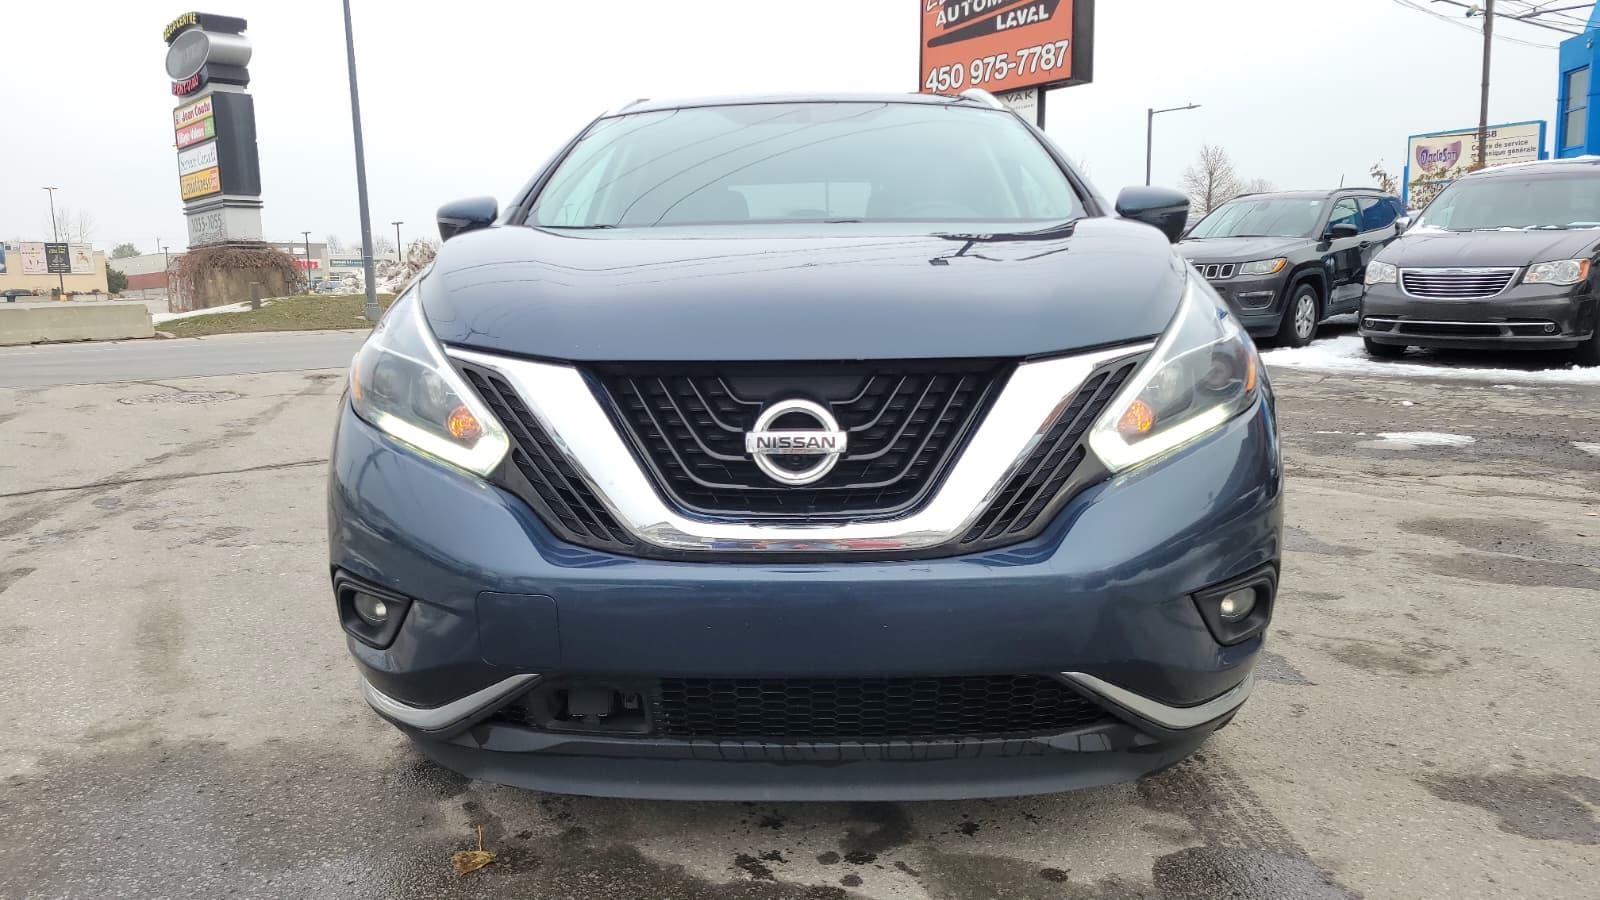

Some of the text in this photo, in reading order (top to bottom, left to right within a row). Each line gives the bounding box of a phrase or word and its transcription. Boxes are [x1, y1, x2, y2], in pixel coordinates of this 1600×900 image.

[996, 4, 1049, 31] LAVAL
[925, 39, 1069, 92] 450 975-7787
[1471, 131, 1497, 140] 158
[1503, 139, 1529, 148] service
[1471, 150, 1506, 159] manique
[756, 436, 836, 449] NISSAN
